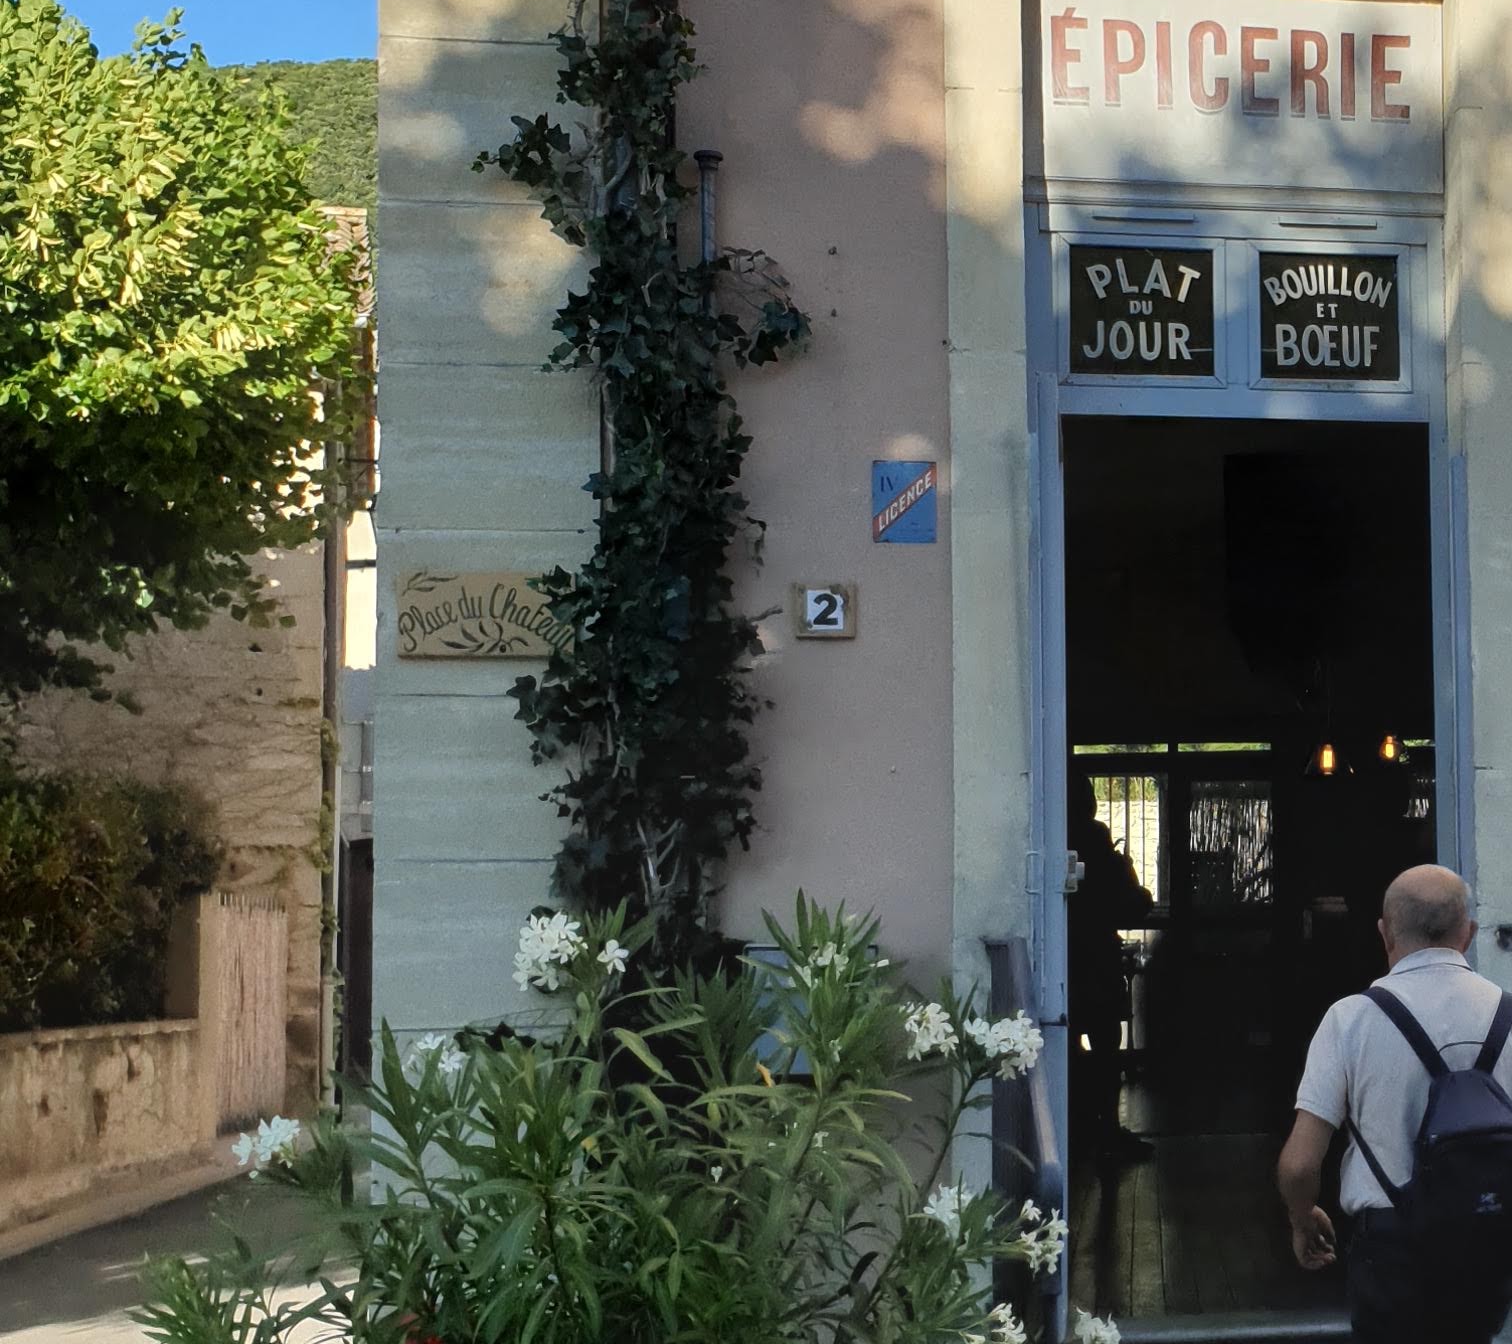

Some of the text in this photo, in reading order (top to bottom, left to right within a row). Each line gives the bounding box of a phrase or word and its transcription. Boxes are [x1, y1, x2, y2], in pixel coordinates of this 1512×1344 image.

[1051, 7, 1411, 122] ÉPICERIE
[1086, 258, 1201, 303] PLAT
[1264, 264, 1392, 308] BOUILLON
[1129, 300, 1153, 315] DU
[1317, 303, 1338, 318] ET
[1083, 320, 1192, 360] JOUR
[879, 470, 932, 532] LICENCE
[399, 601, 458, 652] Place
[458, 585, 483, 620] du
[813, 593, 838, 626] 2
